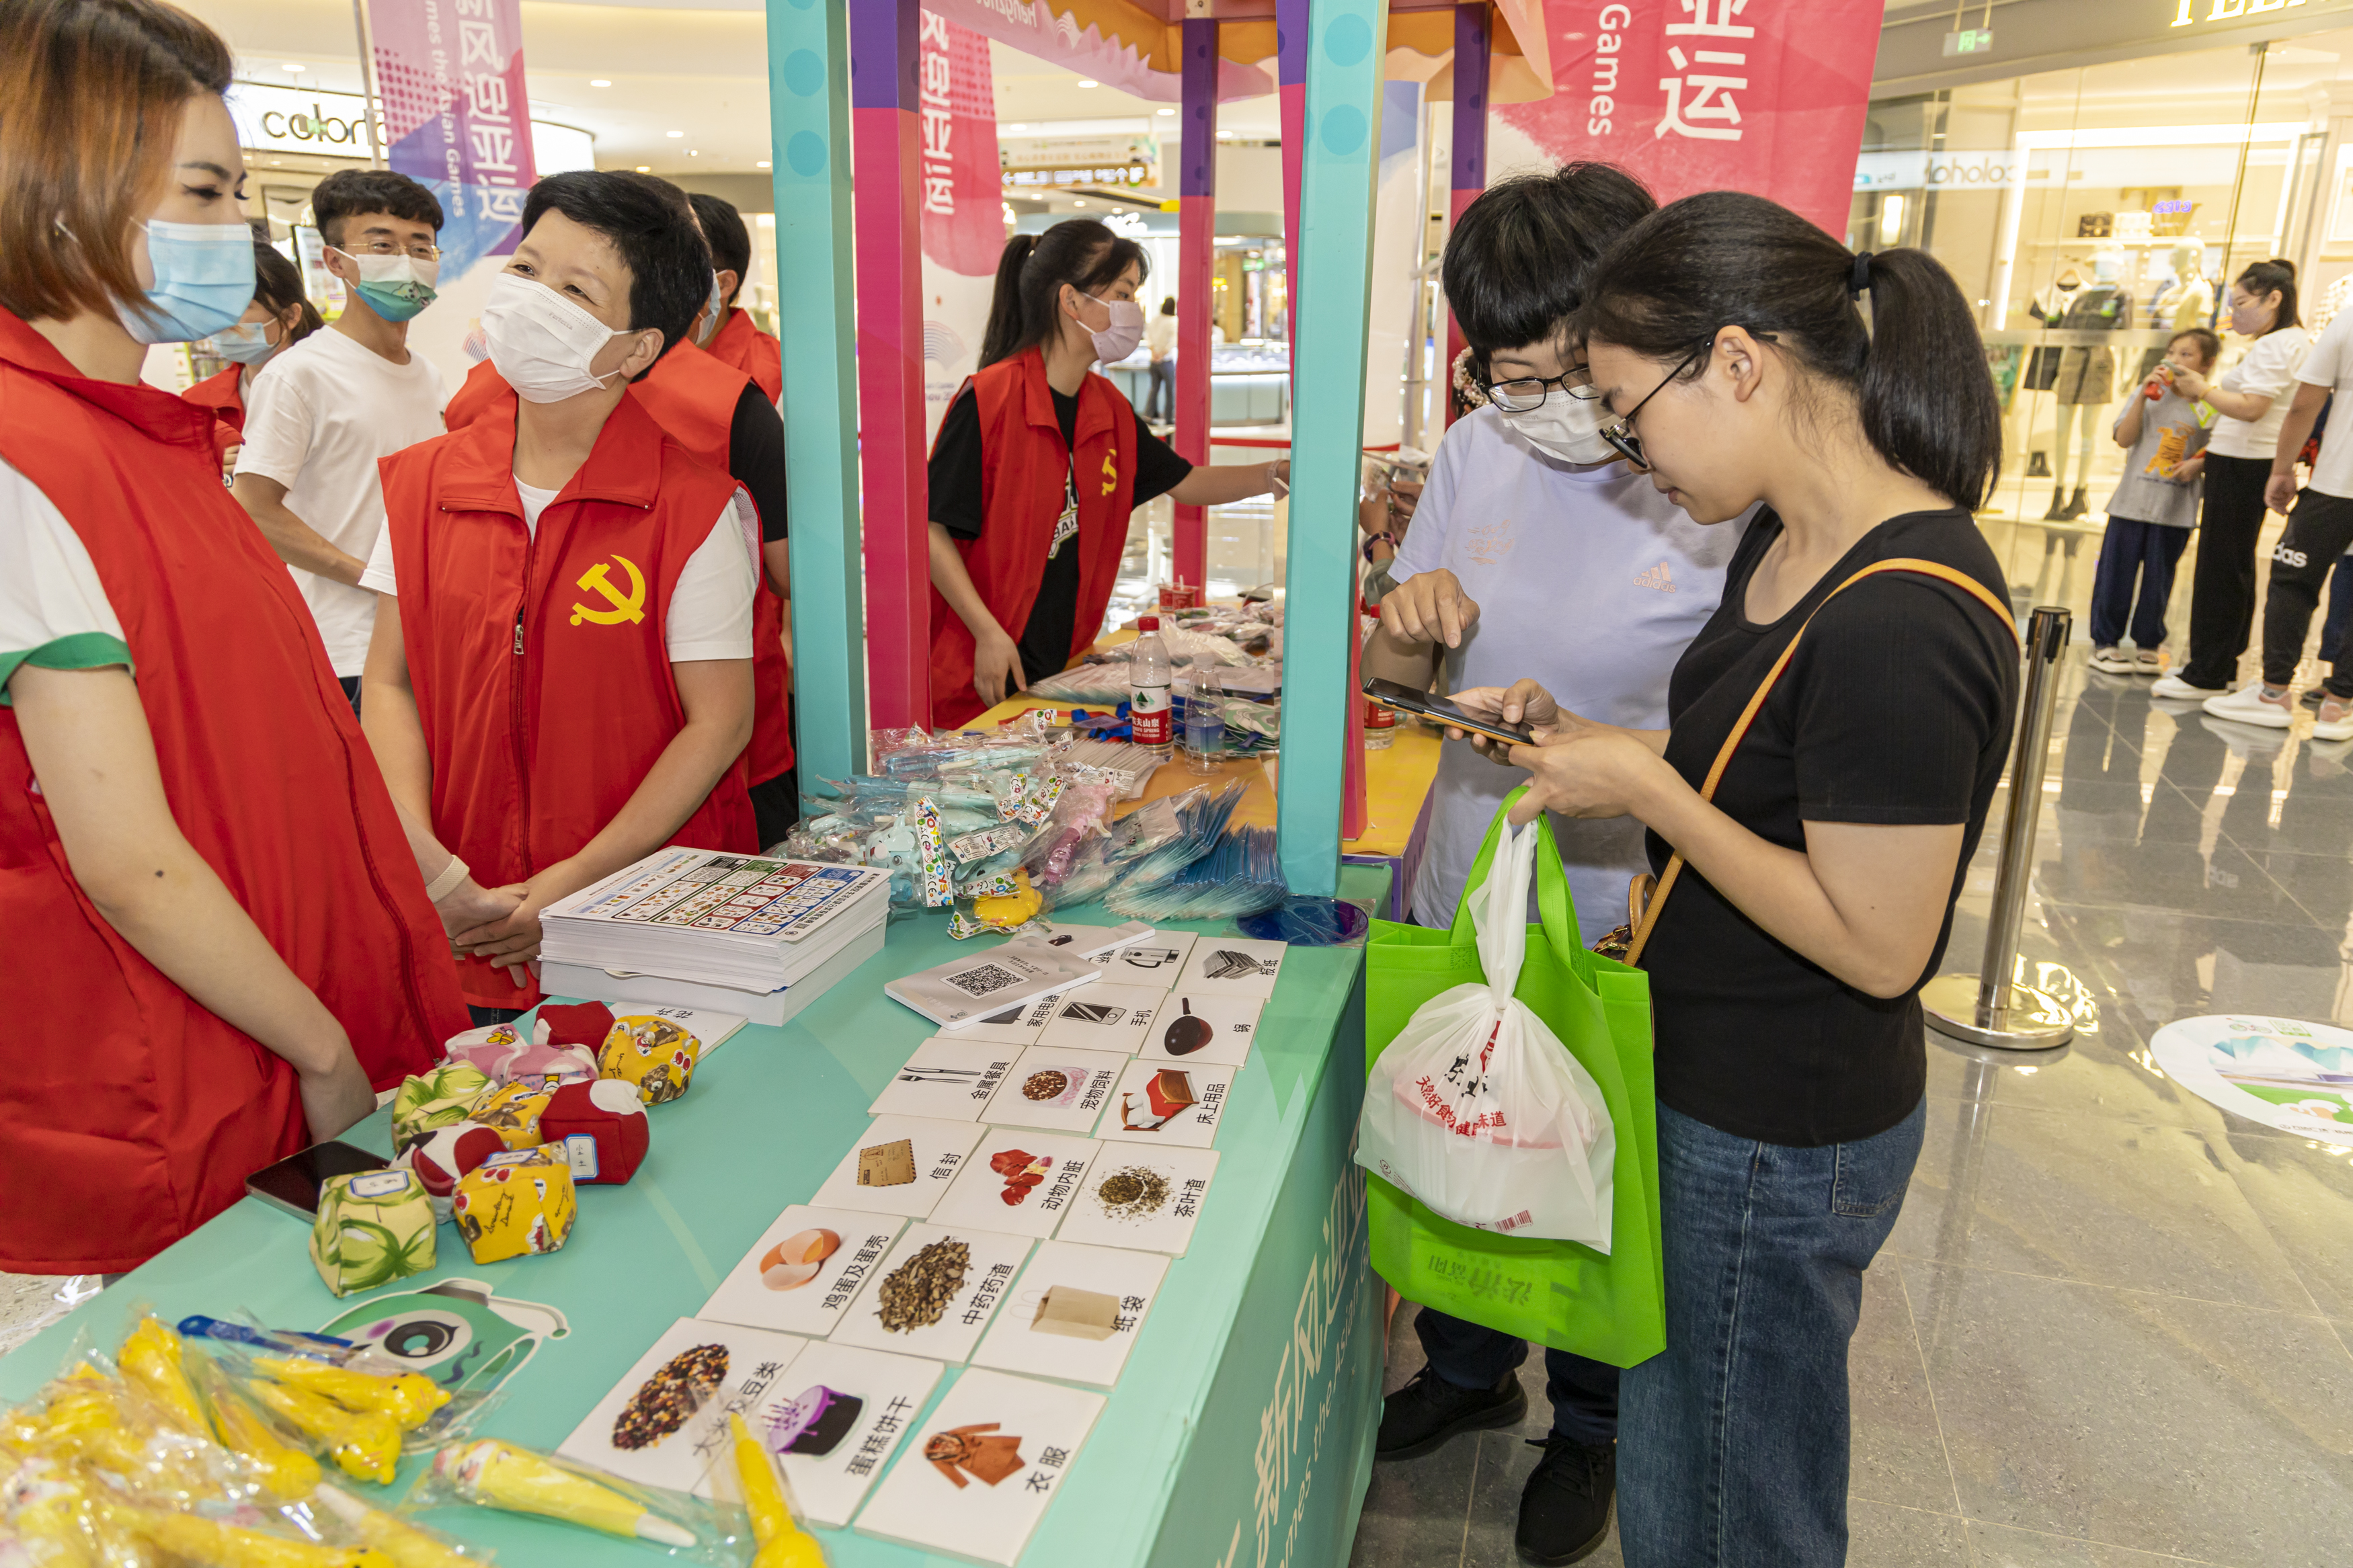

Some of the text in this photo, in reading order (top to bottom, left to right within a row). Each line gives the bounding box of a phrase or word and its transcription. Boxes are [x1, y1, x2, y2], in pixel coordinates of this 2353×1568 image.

[432, 50, 449, 84] the
[1587, 4, 1631, 136] Games
[438, 88, 457, 144] Asian
[446, 148, 465, 218] Games
[1633, 575, 1677, 594] adidas
[1259, 959, 1279, 977] 报纸
[1026, 995, 1061, 1028] 家用电器
[1130, 1009, 1152, 1028] 手机
[1232, 1023, 1251, 1034] 锅
[970, 1061, 1010, 1101] 金属餐具
[1080, 1070, 1116, 1110] 宠物饲料
[1195, 1083, 1226, 1125] 床上用品
[928, 1153, 961, 1180] 信封
[1040, 1160, 1085, 1210] 动物内脏
[1173, 1178, 1206, 1218] 茶叶渣
[821, 1235, 890, 1310] 鸡蛋及蛋壳
[961, 1263, 1015, 1325] 中药药渣
[1110, 1296, 1146, 1333] 纸袋
[1313, 1379, 1332, 1462] the
[1332, 1278, 1359, 1395] Asian
[844, 1395, 914, 1477] 蛋糕饼干
[1025, 1446, 1071, 1493] 衣服
